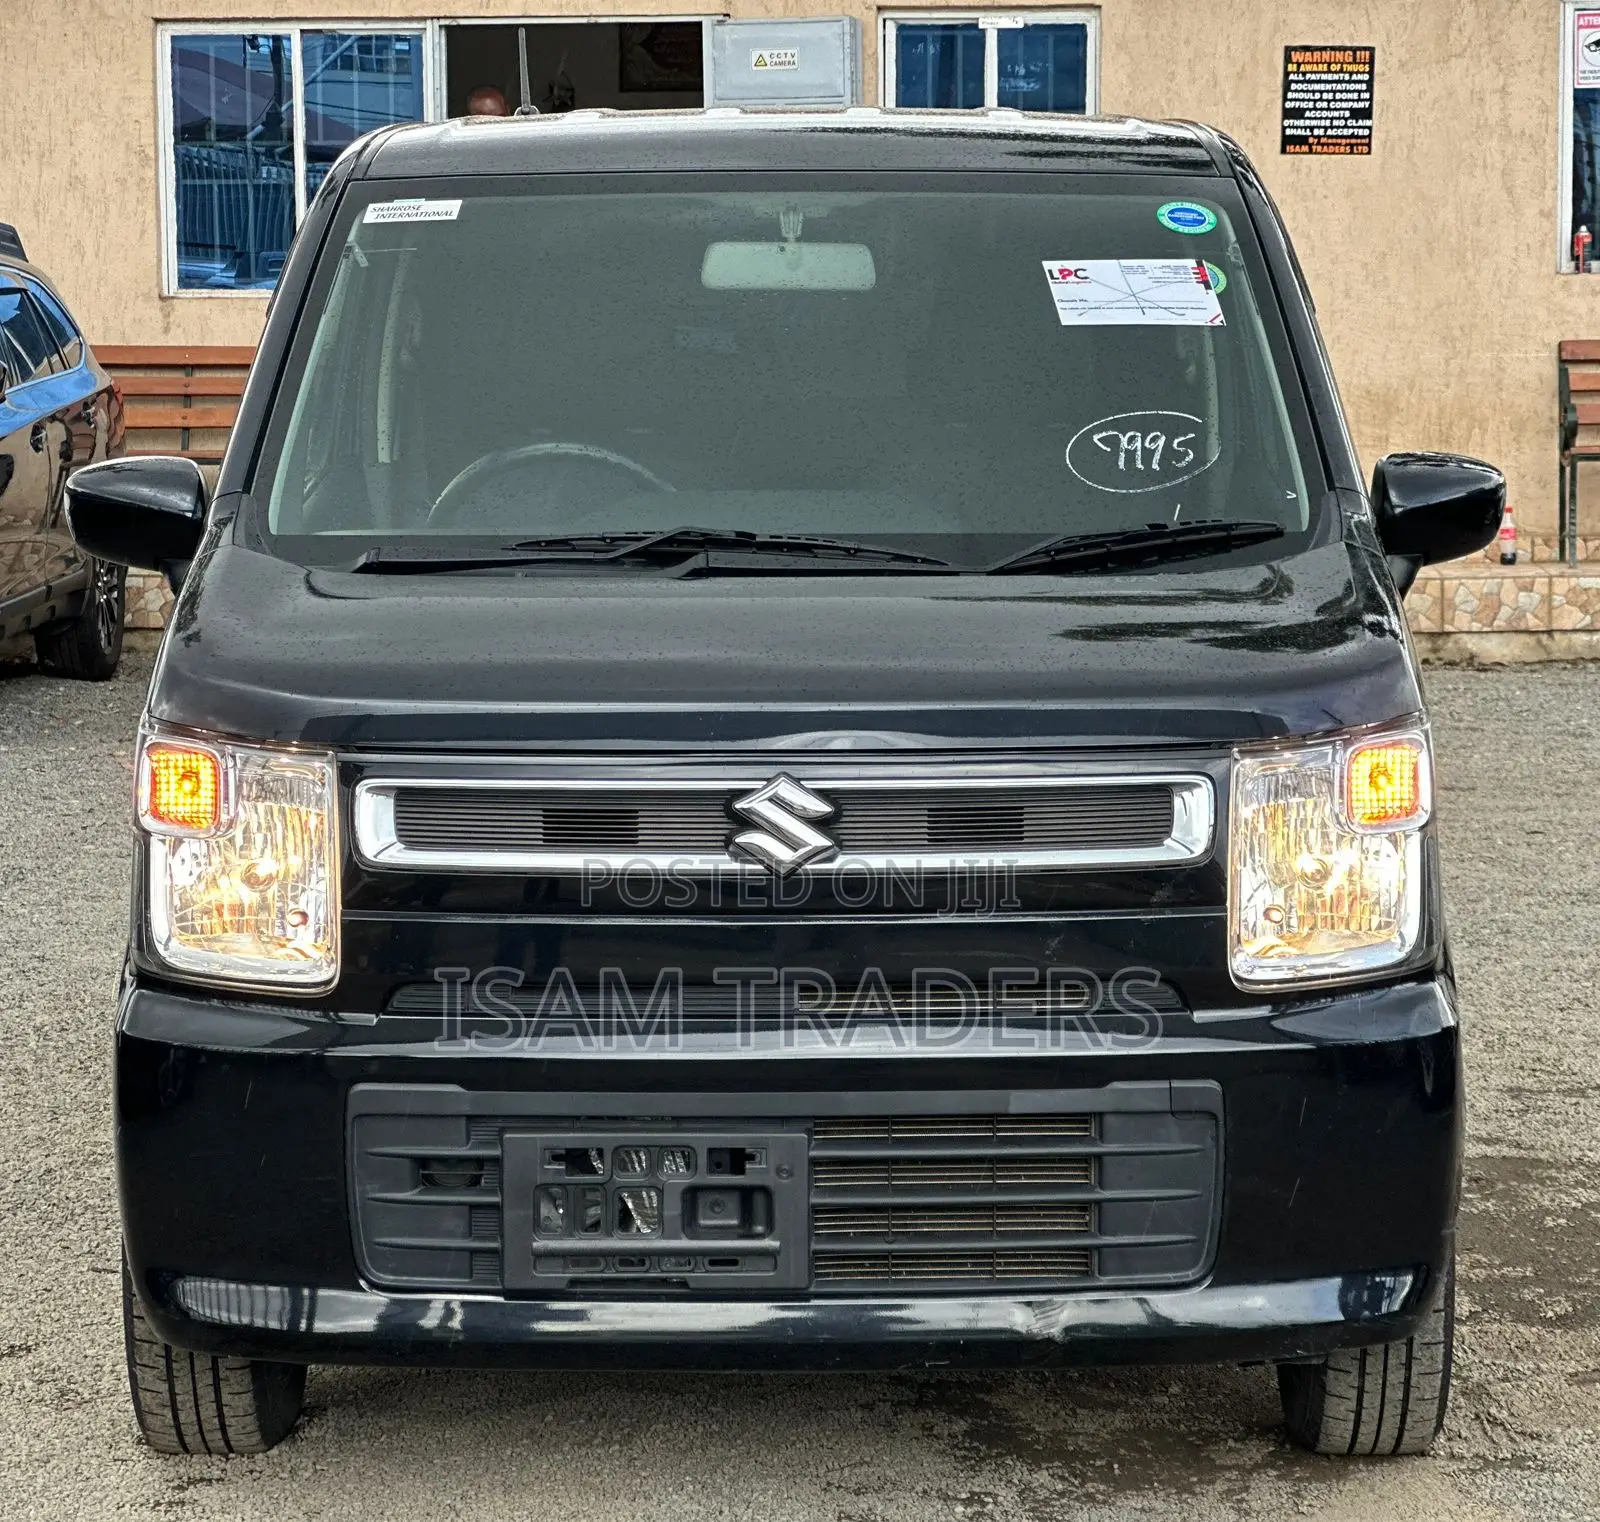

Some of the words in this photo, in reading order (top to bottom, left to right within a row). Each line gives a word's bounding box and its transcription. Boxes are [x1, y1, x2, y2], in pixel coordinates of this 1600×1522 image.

[1291, 51, 1353, 63] WARNING
[1356, 51, 1370, 63] !!!
[1287, 63, 1298, 72] BE
[1299, 63, 1328, 72] AWARE
[1330, 63, 1341, 72] OF
[1343, 63, 1370, 72] THUGS
[1287, 92, 1321, 100] SHOULD
[1322, 92, 1334, 100] BE
[1335, 92, 1359, 100] DONE
[1360, 92, 1370, 100] IN
[1285, 101, 1314, 109] OFFICE
[1315, 101, 1328, 109] OR
[1329, 101, 1370, 109] COMPANY
[1304, 110, 1351, 118] ACCOUNTS
[1283, 119, 1331, 127] OTHERWISE
[1332, 119, 1346, 127] NO
[1346, 119, 1372, 127] CLAIM
[1285, 128, 1312, 136] SHALL
[1313, 128, 1325, 136] BE
[1326, 128, 1370, 136] ACCEPTED
[1308, 137, 1318, 145] By
[1320, 137, 1369, 145] Management
[1286, 145, 1309, 153] ISAM
[1311, 145, 1351, 153] TRADERS
[1353, 145, 1369, 153] LTD
[370, 204, 424, 213] SHAHROSE
[373, 210, 454, 220] INTERNATIONAL
[1047, 268, 1090, 280] LPC
